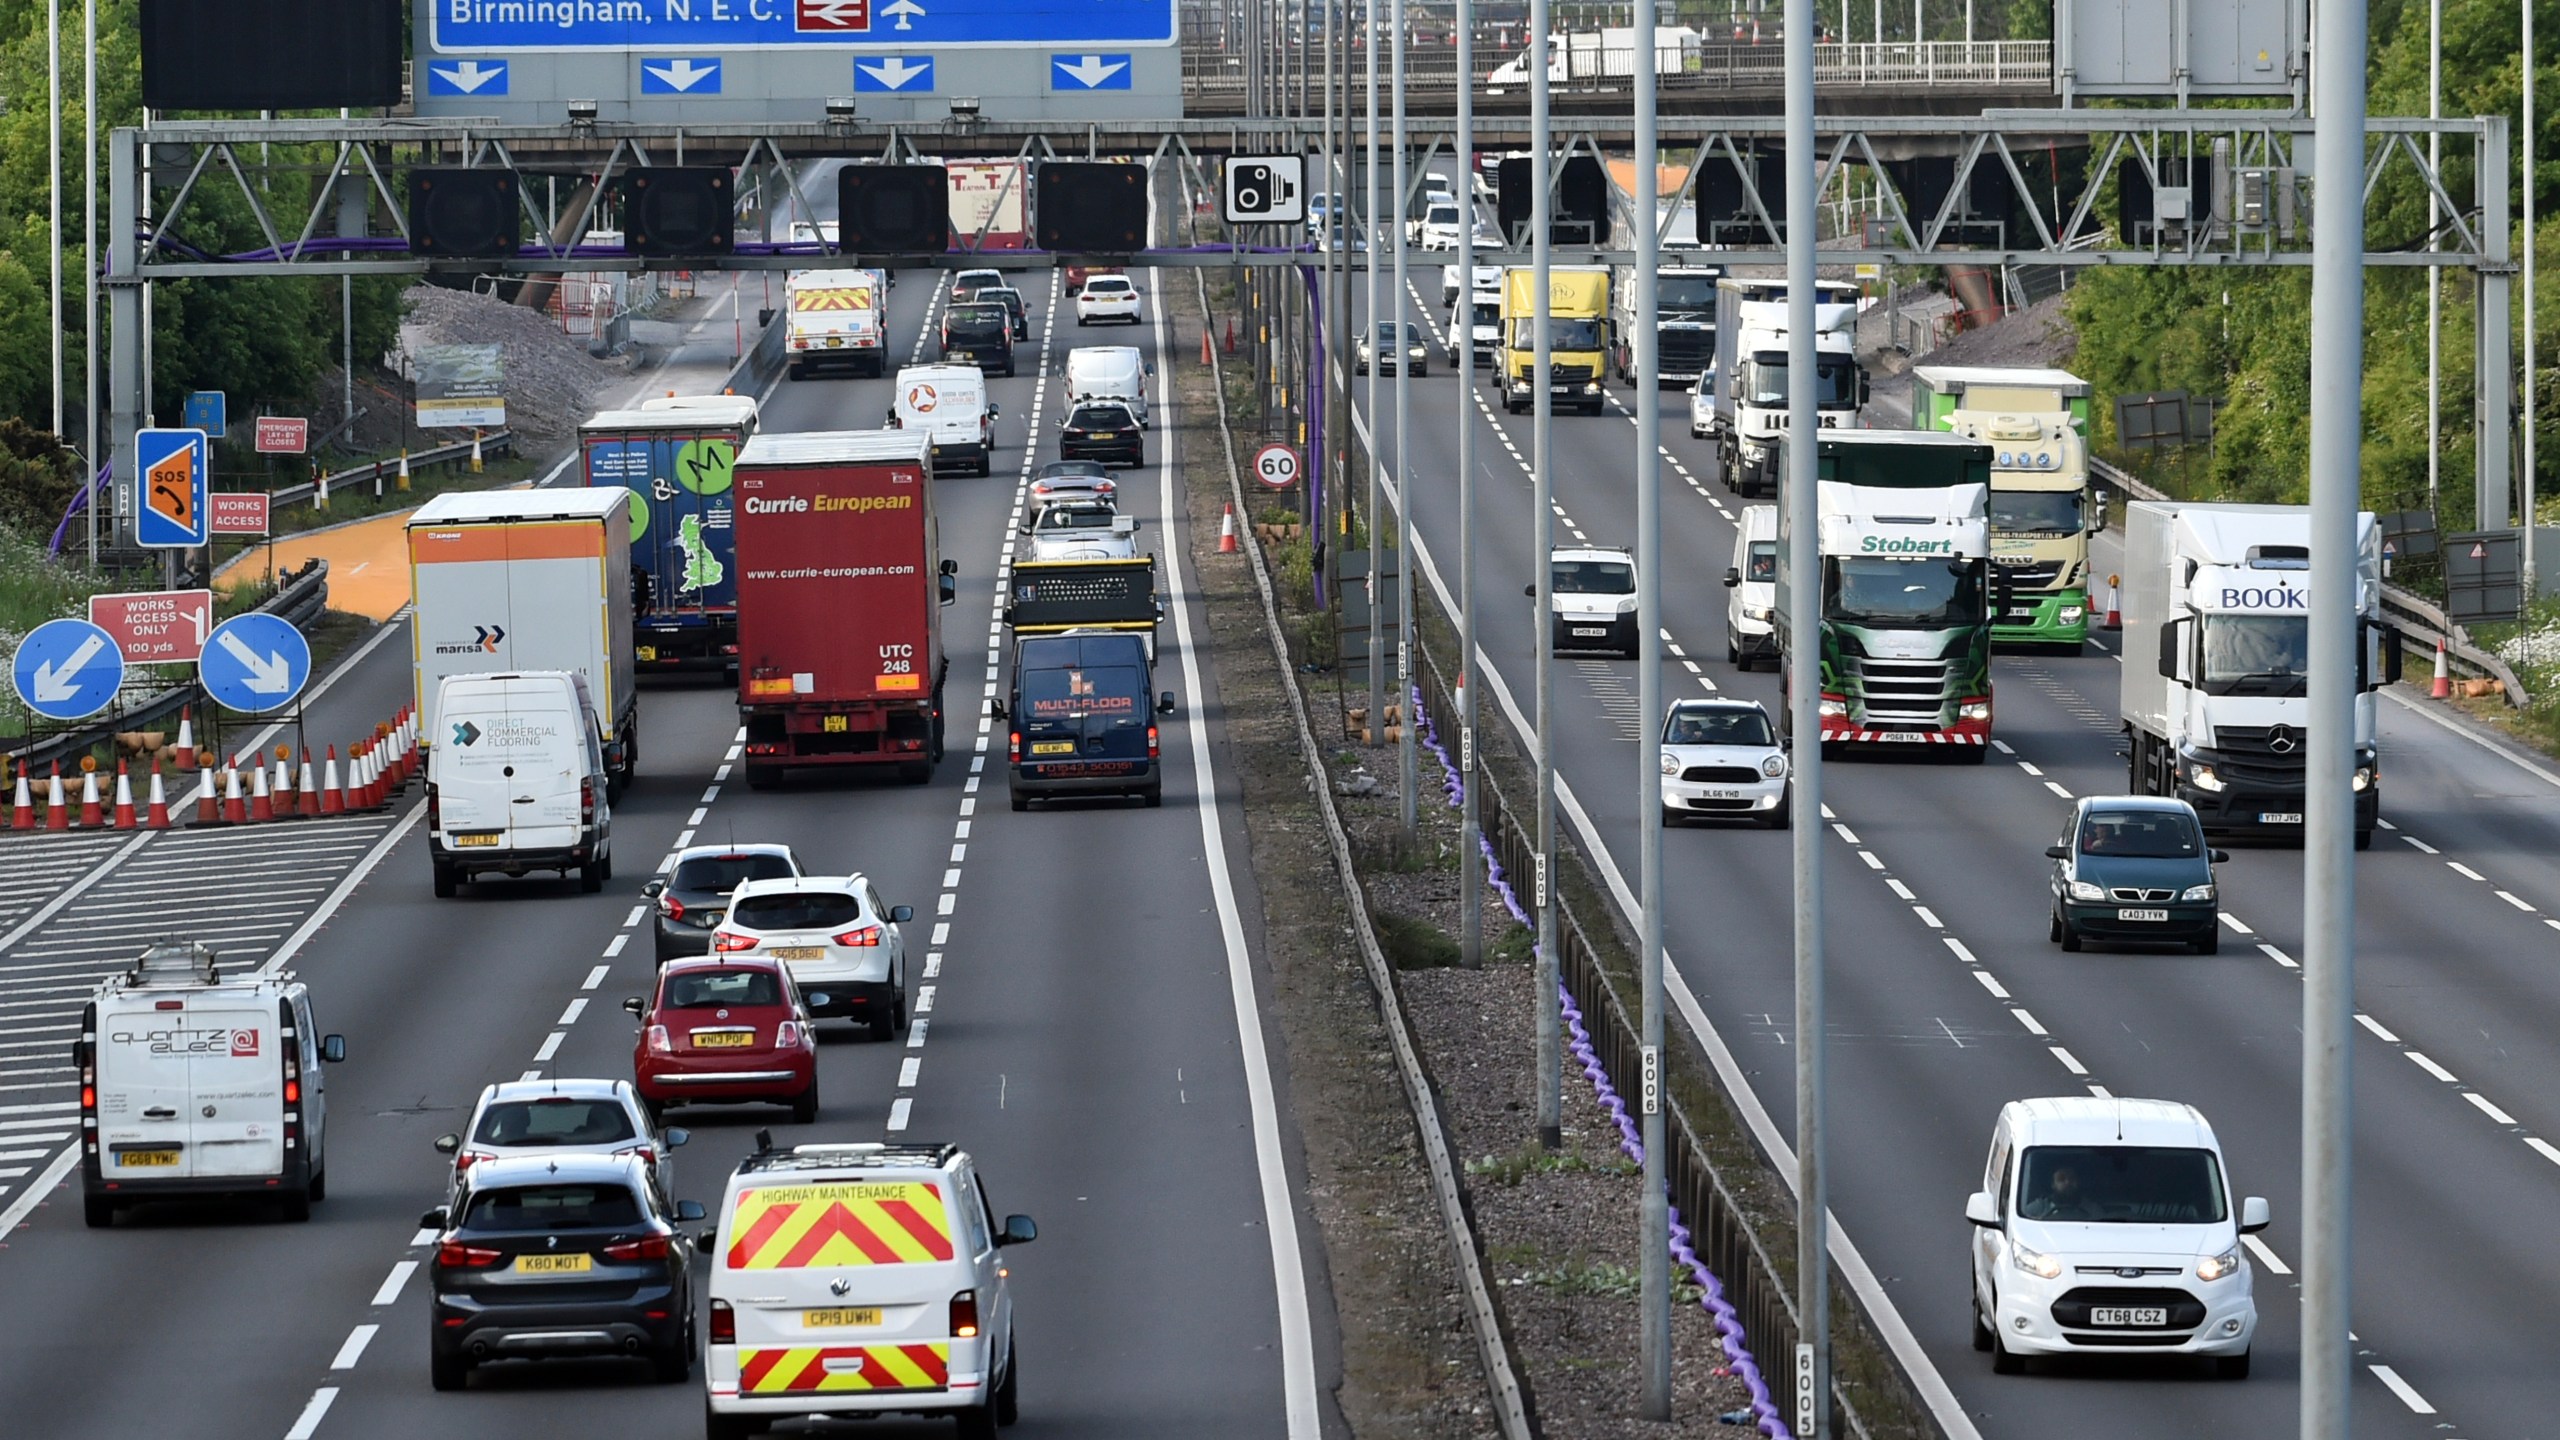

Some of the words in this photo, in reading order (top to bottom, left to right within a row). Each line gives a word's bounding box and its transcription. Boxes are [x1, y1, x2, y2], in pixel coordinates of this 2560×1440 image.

[450, 0, 653, 28] Birmingham,
[259, 424, 304, 432] EMERGENCY
[265, 438, 296, 446] CLOSED
[686, 446, 726, 483] M
[1261, 457, 1294, 476] 60
[154, 470, 186, 482] SOS
[651, 477, 681, 501] &
[218, 501, 261, 511] WORKS
[745, 495, 808, 514] Currie
[813, 494, 912, 514] European
[215, 516, 263, 526] ACCESS
[1860, 535, 1952, 554] Stobart
[1994, 554, 2033, 563] IVECO
[747, 565, 914, 580] www.currie-european.com
[2222, 588, 2310, 609] BOOK
[126, 600, 175, 612] WORKS
[124, 612, 177, 625] ACCESS
[132, 624, 169, 636] ONLY
[128, 644, 149, 653] 100
[153, 642, 174, 654] yds
[436, 644, 482, 654] marisa
[879, 644, 913, 658] UTC
[882, 660, 911, 674] 248
[1034, 697, 1132, 711] MULTI-FLOOR
[486, 718, 524, 728] DIRECT
[487, 726, 558, 737] COMMERCIAL
[487, 736, 541, 747] FLOORING
[1537, 859, 1545, 905] 6007
[2122, 910, 2145, 919] CA03
[2147, 911, 2164, 920] YVK
[700, 1034, 722, 1045] WN13
[1646, 1052, 1656, 1112] 6006
[122, 1152, 151, 1165] FG68
[762, 1188, 816, 1202] HIGHWAY
[820, 1186, 906, 1200] MAINTENANCE
[555, 1256, 581, 1269] MOT
[810, 1312, 842, 1326] CP19
[846, 1310, 873, 1324] UWH
[2096, 1310, 2132, 1322] CT68
[2134, 1310, 2161, 1322] CSZ
[1800, 1354, 1810, 1433] 6005
